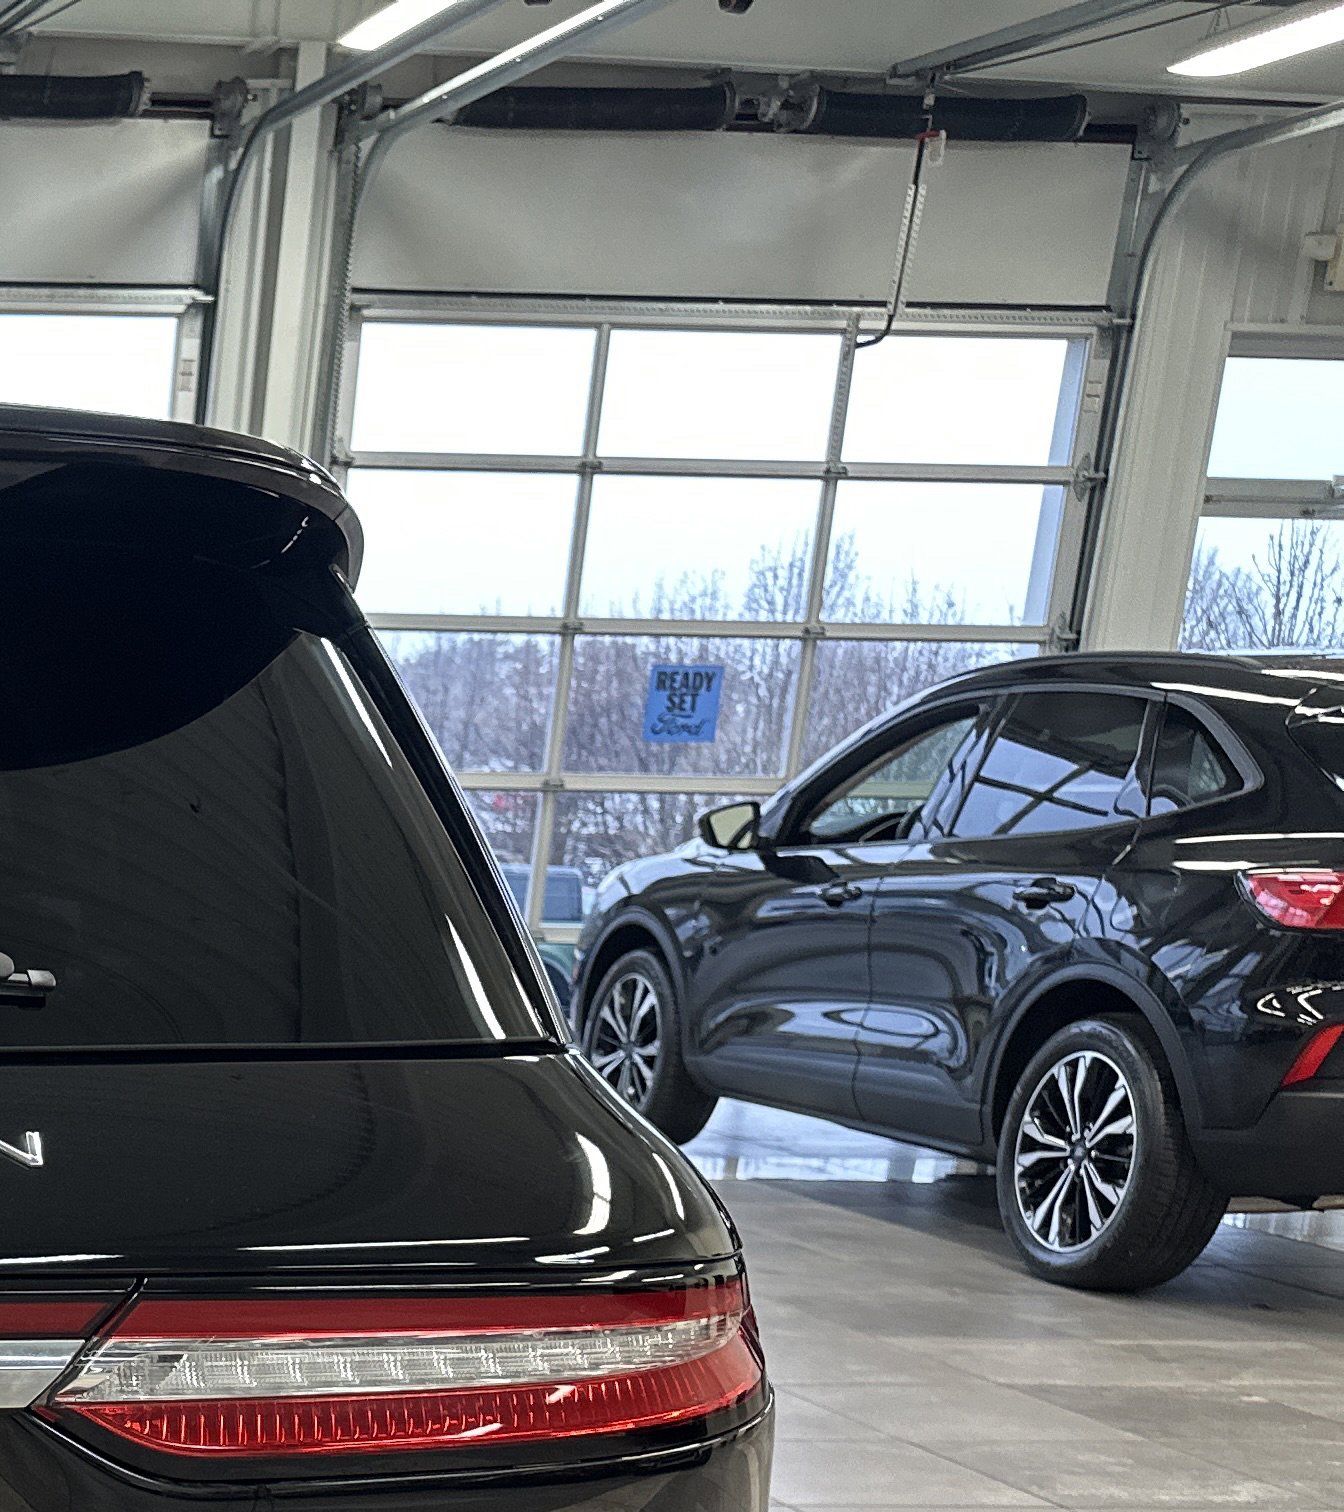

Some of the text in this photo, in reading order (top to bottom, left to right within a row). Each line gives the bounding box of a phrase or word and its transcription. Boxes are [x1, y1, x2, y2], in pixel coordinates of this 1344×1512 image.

[656, 671, 716, 692] READY
[666, 693, 699, 712] SET
[651, 713, 707, 736] Ford
